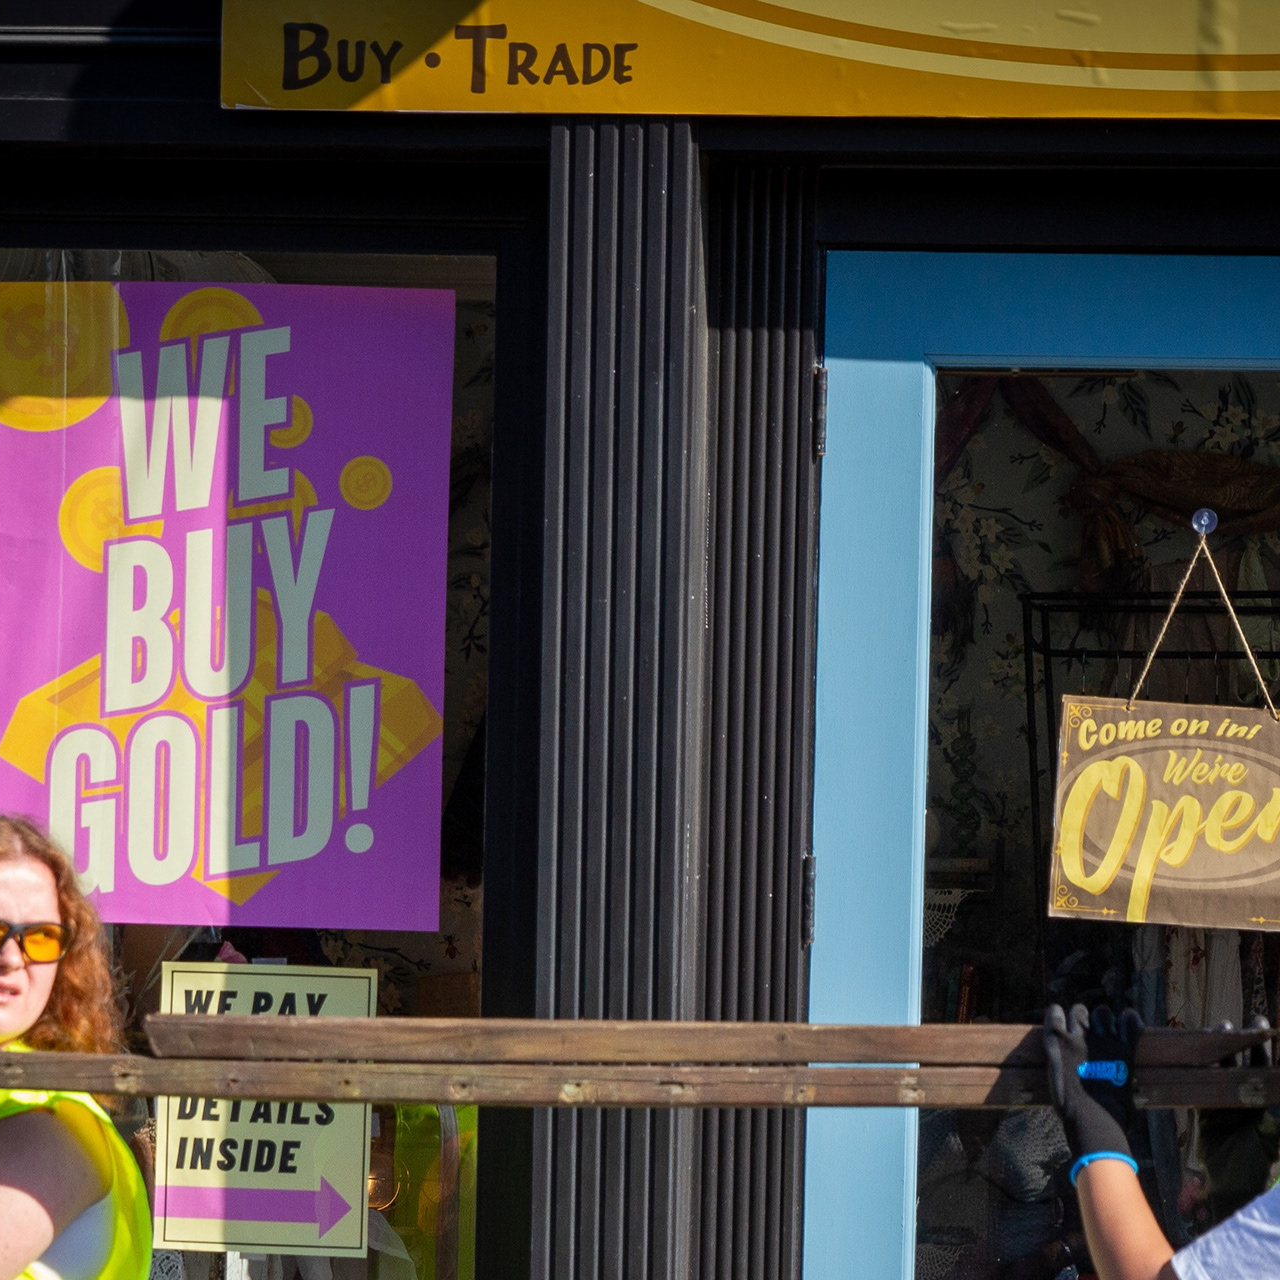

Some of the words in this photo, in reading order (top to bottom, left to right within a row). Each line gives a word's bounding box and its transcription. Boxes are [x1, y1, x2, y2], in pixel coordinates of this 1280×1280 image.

[116, 326, 291, 521] WE
[104, 508, 335, 714] BUY
[49, 683, 376, 896] GOLD!
[1078, 718, 1162, 751] Come
[1170, 718, 1210, 738] on
[175, 1137, 302, 1174] INSIDE
[176, 1096, 336, 1127] DETAILS
